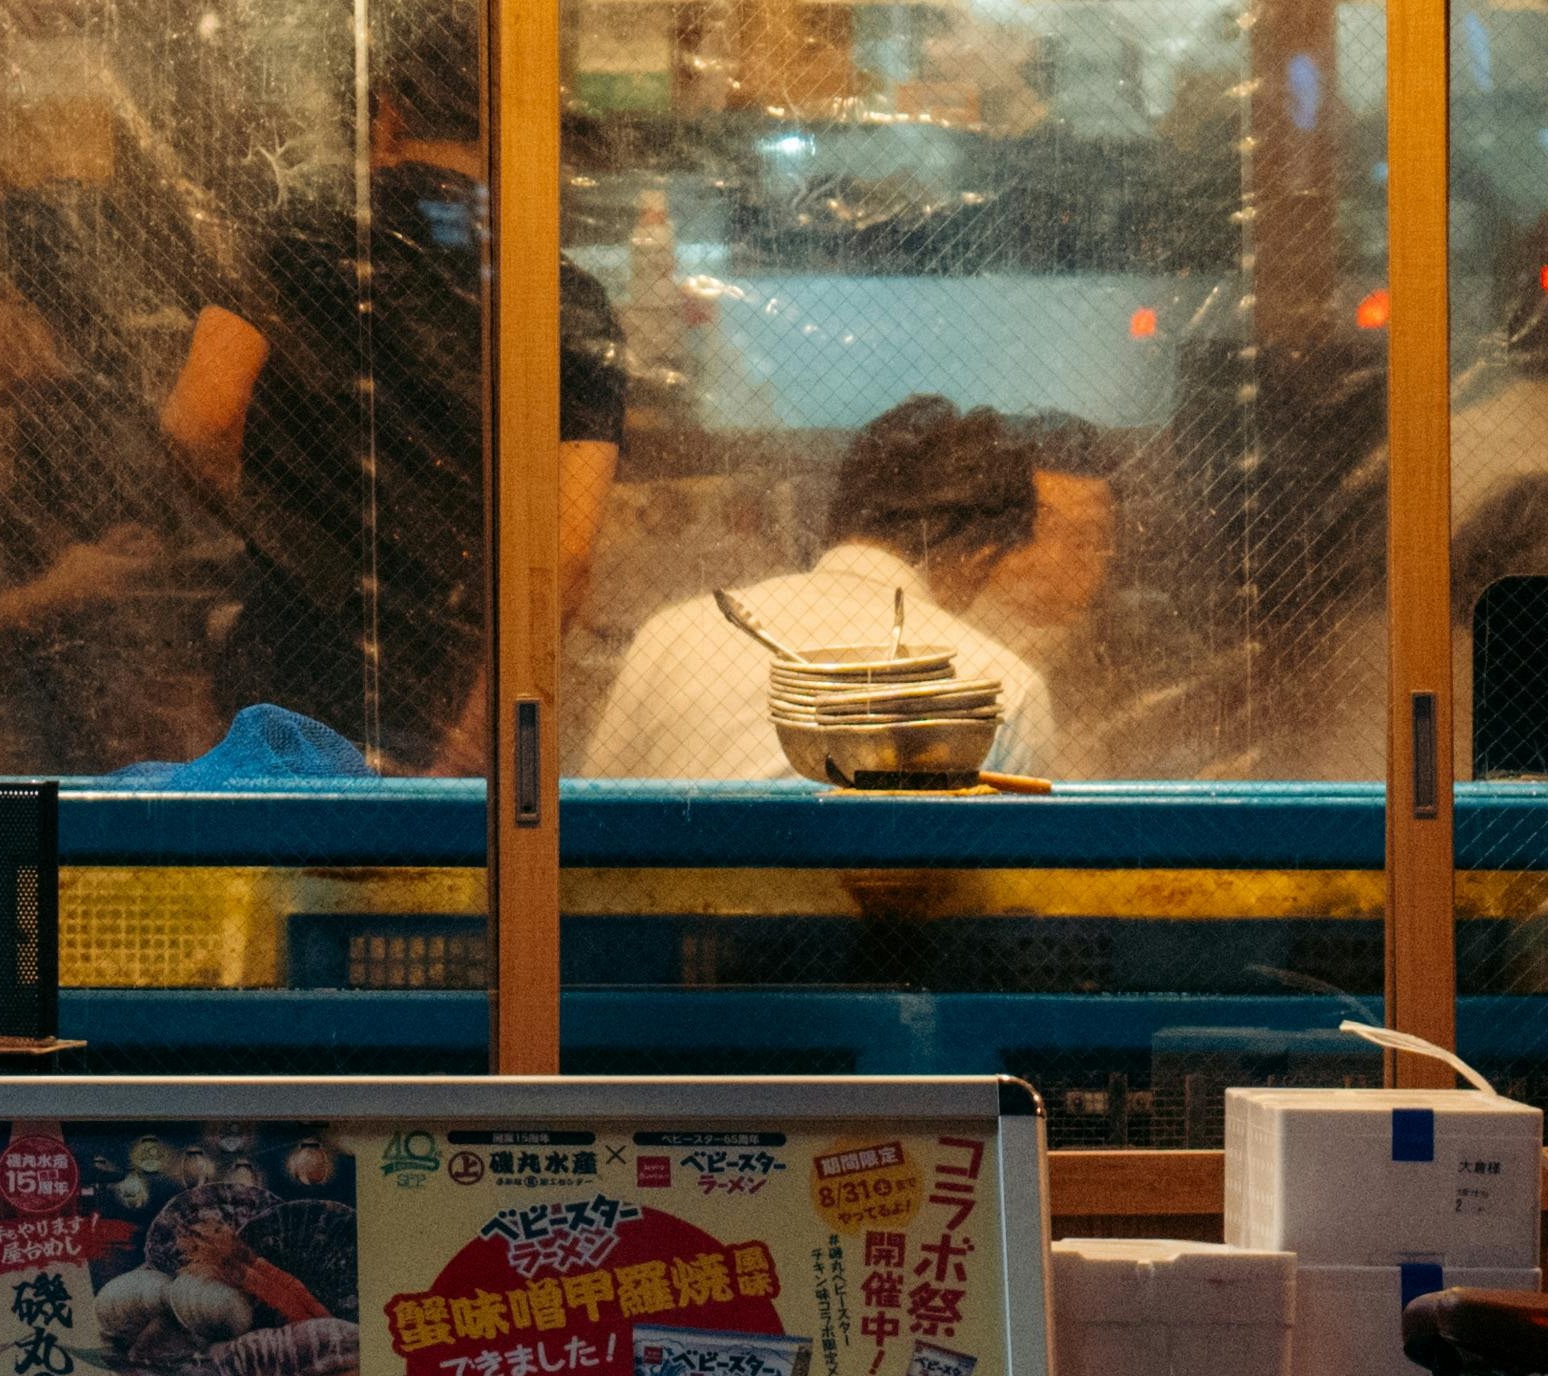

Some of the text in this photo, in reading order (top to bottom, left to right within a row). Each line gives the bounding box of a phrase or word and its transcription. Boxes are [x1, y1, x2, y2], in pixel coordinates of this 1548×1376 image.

[489, 1152, 597, 1174] 磯丸水産
[681, 1151, 786, 1174] ベビースター
[698, 1175, 766, 1194] ラーメン
[481, 1194, 639, 1241] ベビースター
[908, 1137, 984, 1337] コラボ祭
[860, 1230, 906, 1374] 開催中!
